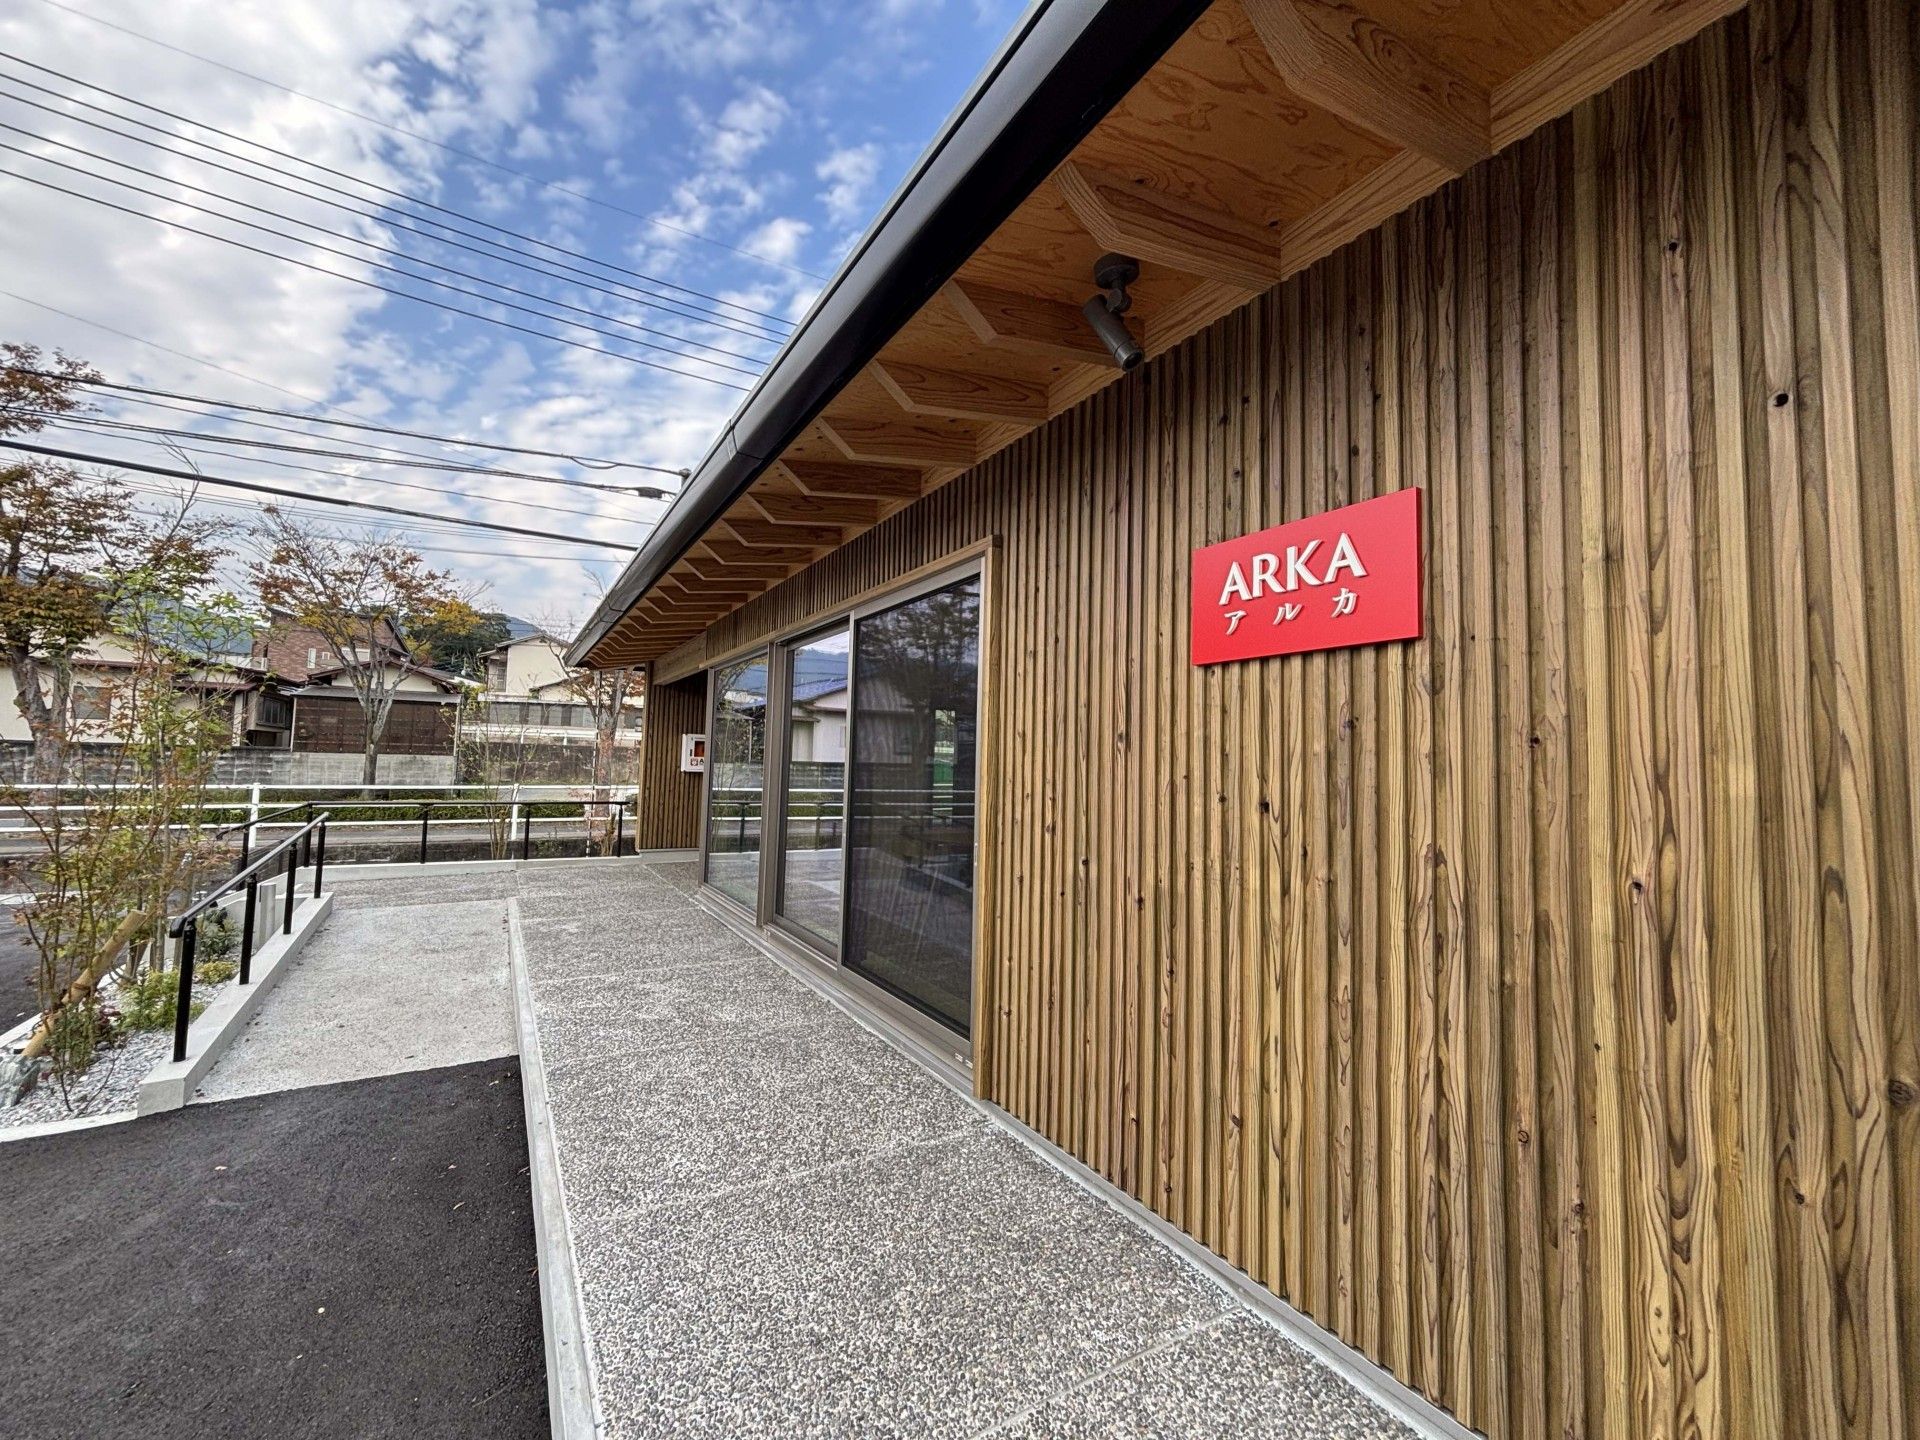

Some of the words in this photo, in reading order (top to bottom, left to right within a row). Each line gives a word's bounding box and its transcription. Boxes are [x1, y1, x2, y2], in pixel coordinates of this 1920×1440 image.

[1218, 532, 1368, 605] ARKA
[1223, 587, 1359, 636] アルカ
